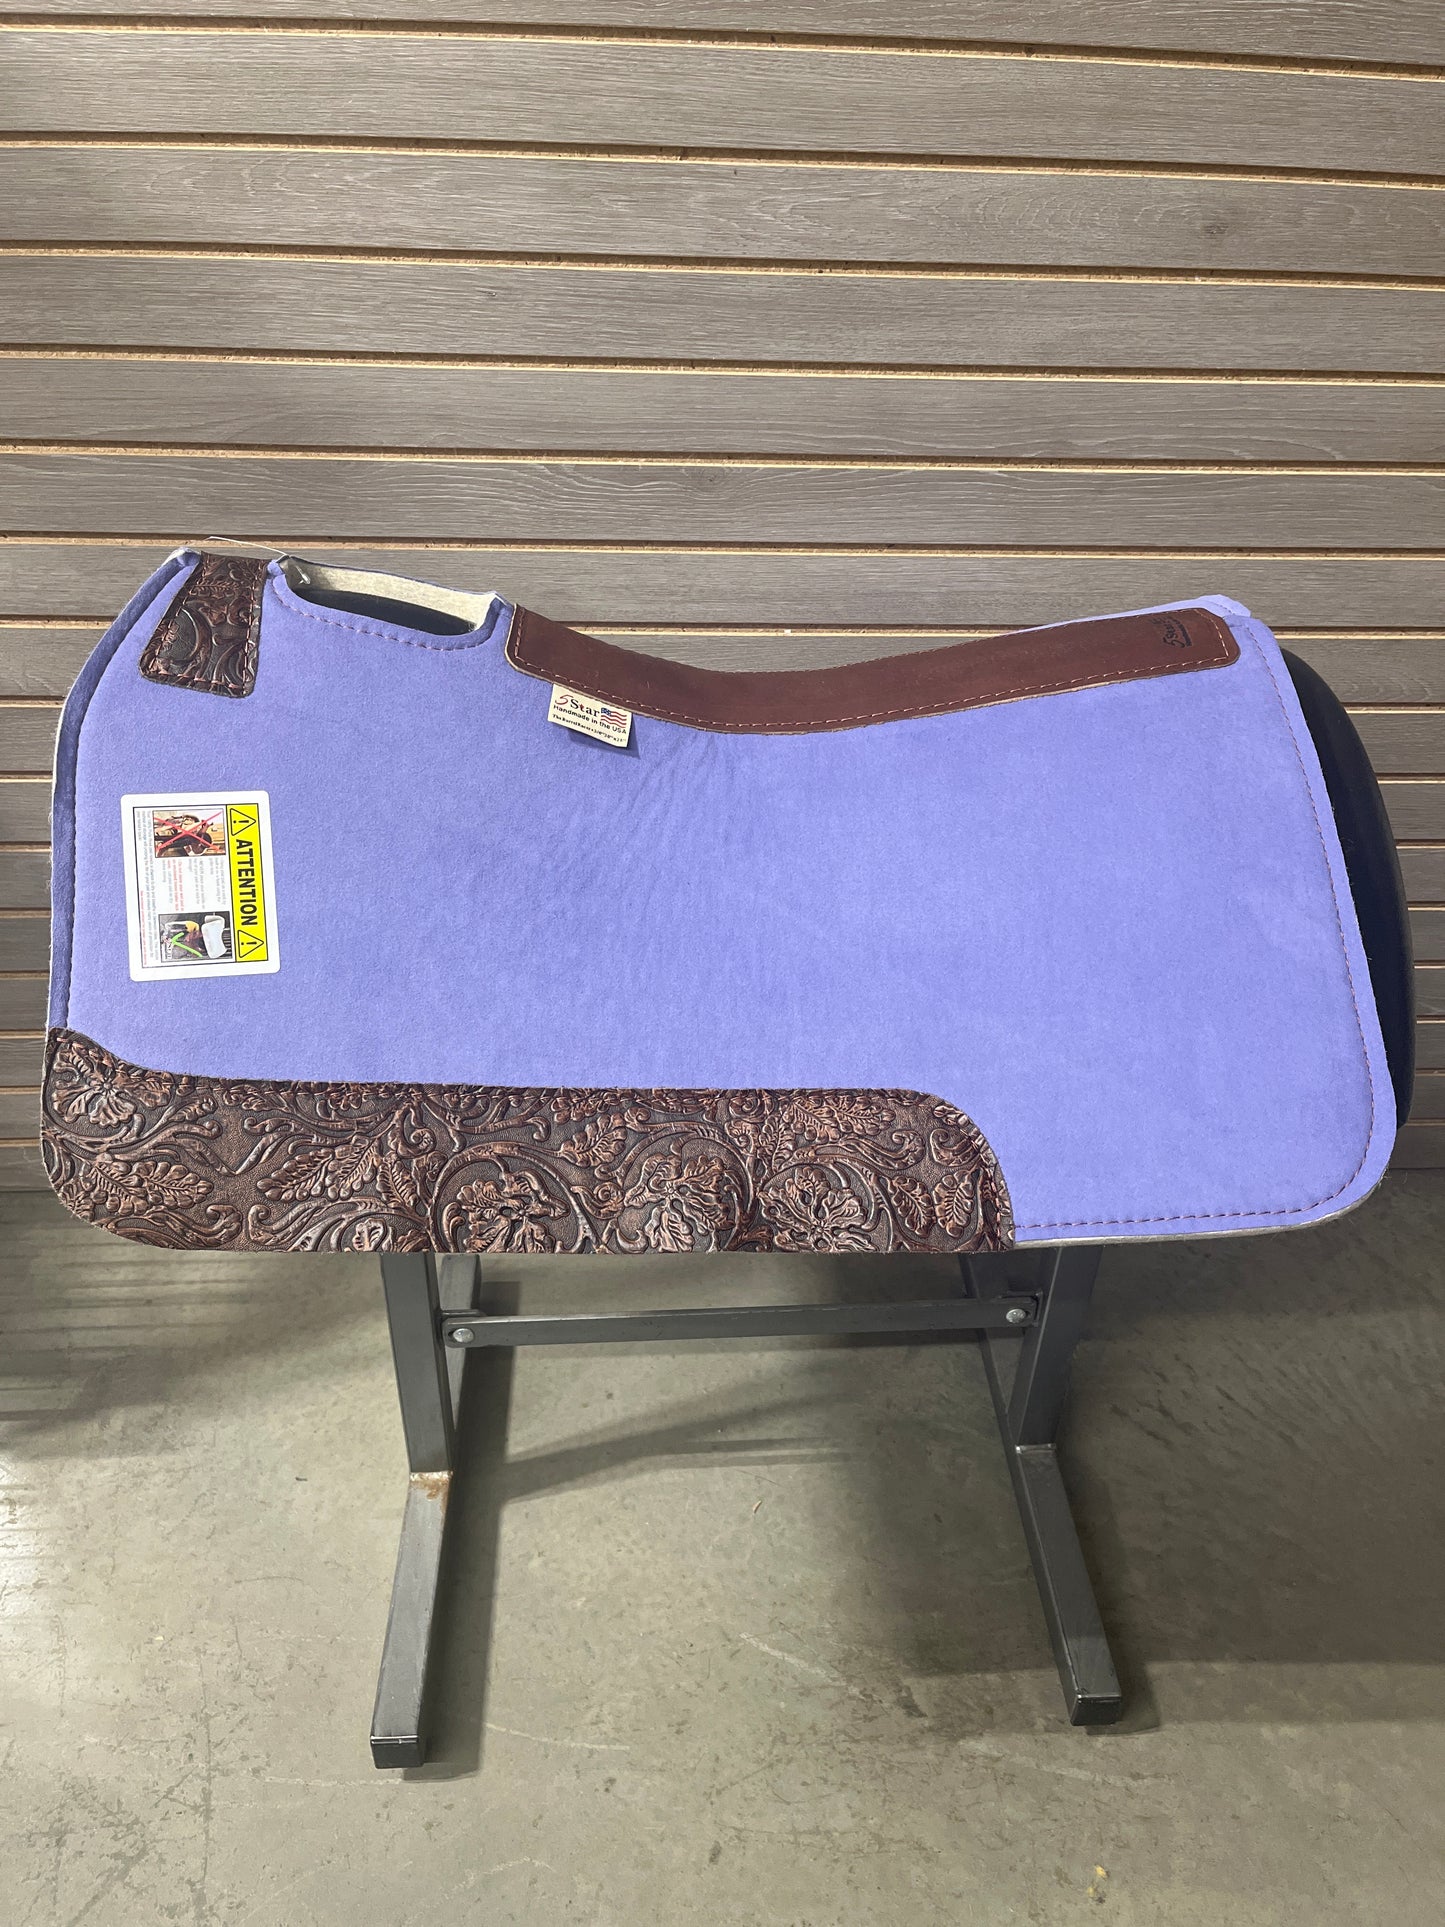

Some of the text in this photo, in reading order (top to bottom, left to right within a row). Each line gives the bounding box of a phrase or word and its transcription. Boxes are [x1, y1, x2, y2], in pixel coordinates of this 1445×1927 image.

[553, 704, 627, 735] Handmade in the USA
[570, 698, 600, 717] Star
[236, 839, 258, 926] ATTENTION
